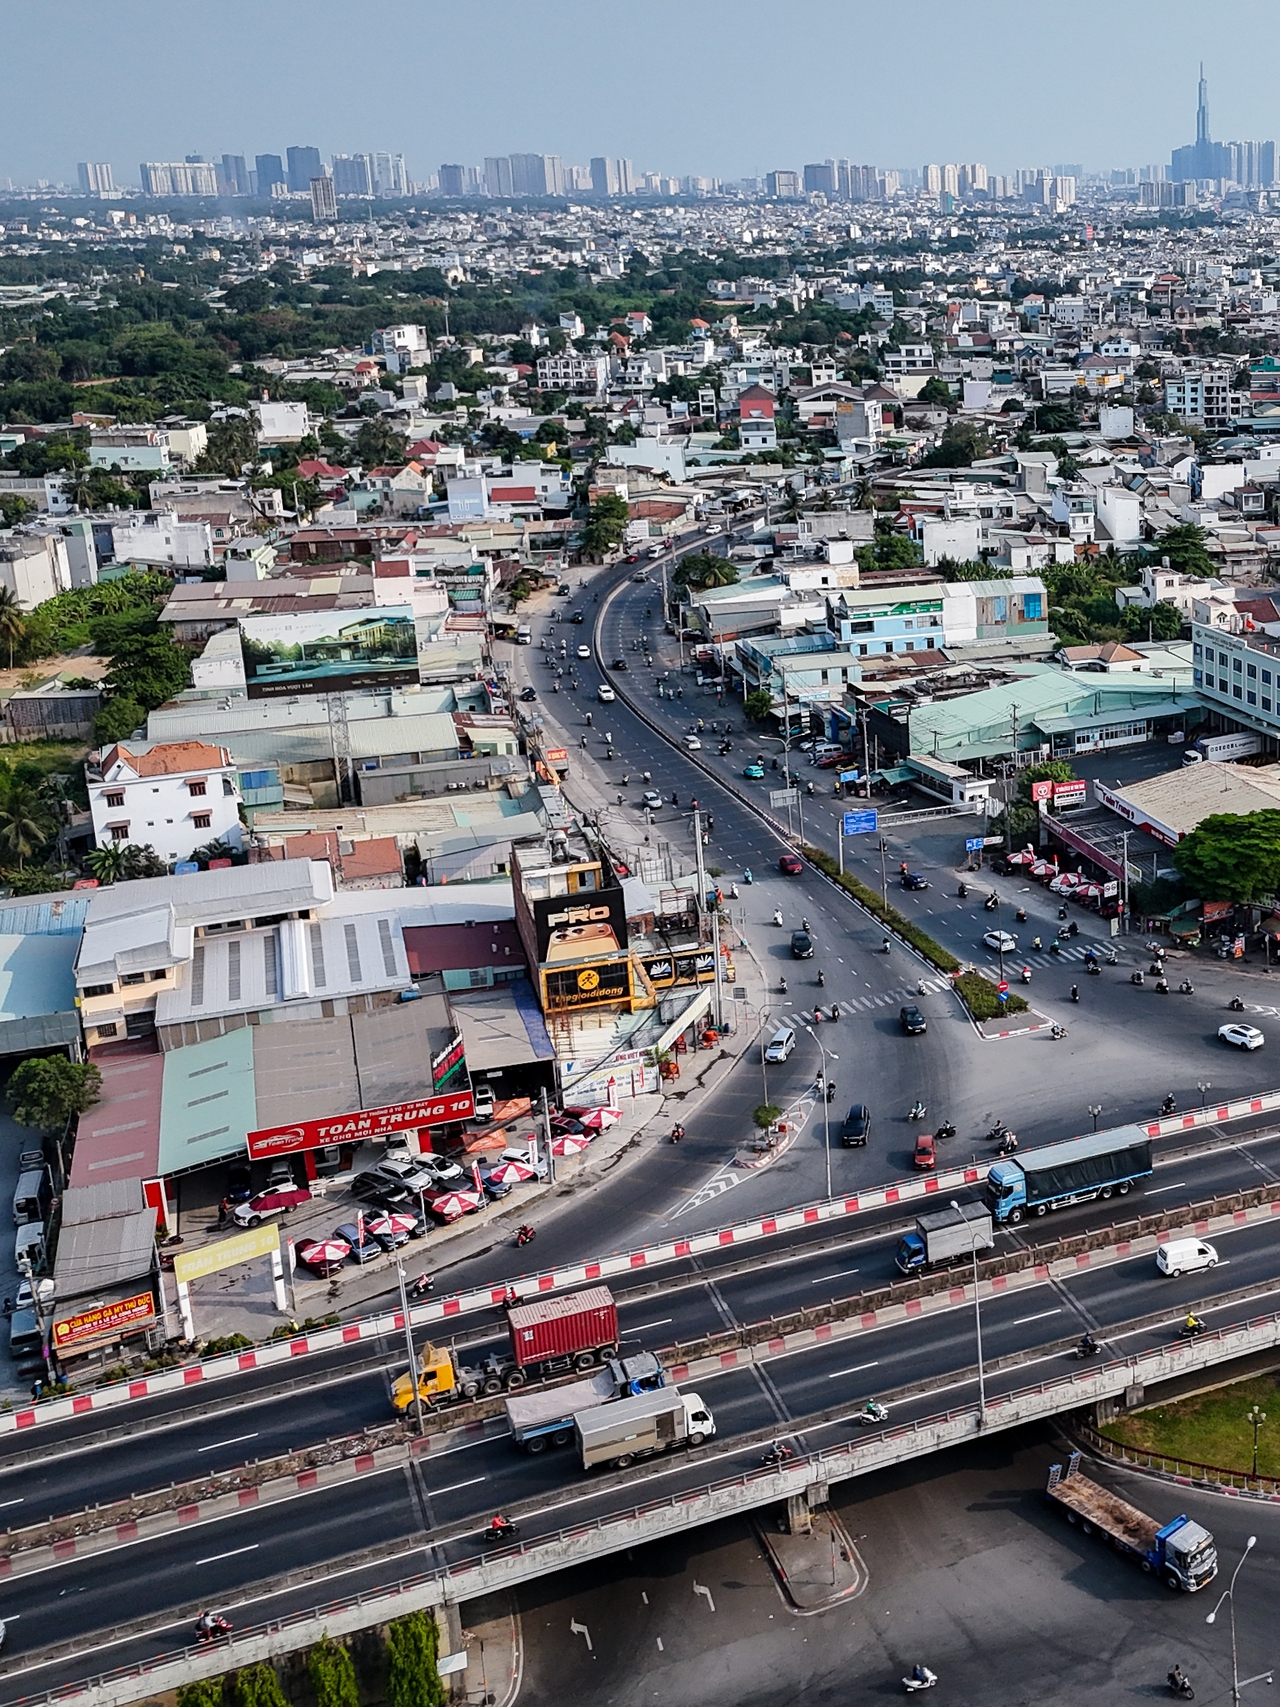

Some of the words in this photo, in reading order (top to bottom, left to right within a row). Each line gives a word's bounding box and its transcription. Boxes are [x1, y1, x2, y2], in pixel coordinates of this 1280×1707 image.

[548, 906, 610, 927] PRO
[555, 987, 623, 1003] thegioididong
[317, 1119, 371, 1137] TOÀN
[378, 1105, 445, 1125] TRUNG
[450, 1100, 470, 1111] 10
[333, 1133, 351, 1141] CHO
[354, 1128, 372, 1138] MỌI
[374, 1124, 392, 1133] NHÀ
[83, 1314, 102, 1324] HÀNG
[103, 1308, 112, 1317] GÀ
